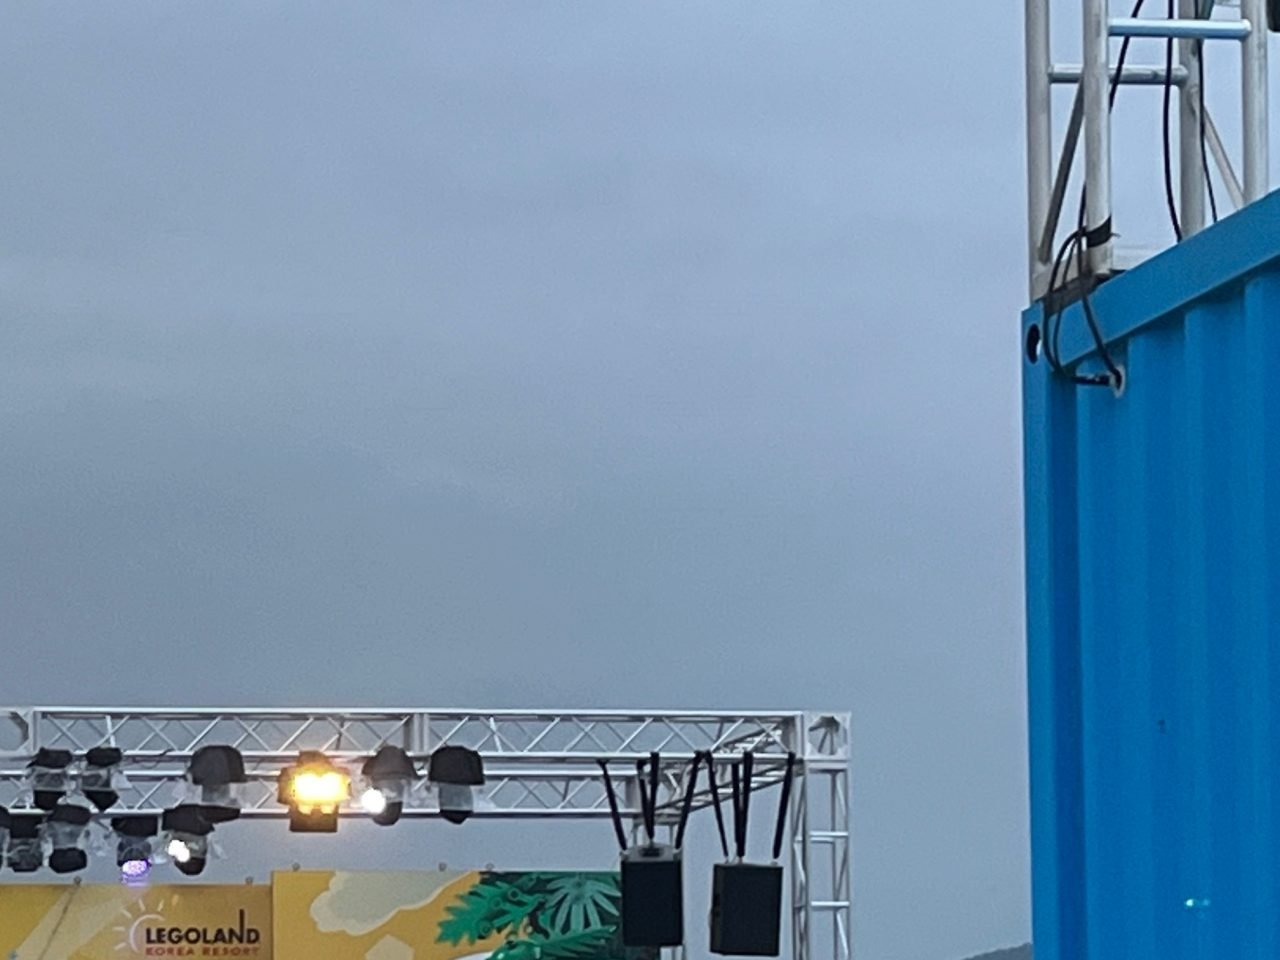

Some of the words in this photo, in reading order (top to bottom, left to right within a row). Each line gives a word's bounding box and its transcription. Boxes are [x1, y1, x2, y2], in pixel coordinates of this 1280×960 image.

[145, 908, 261, 945] LEGOLAND
[145, 946, 195, 957] KOREA
[202, 946, 260, 957] RESORT
